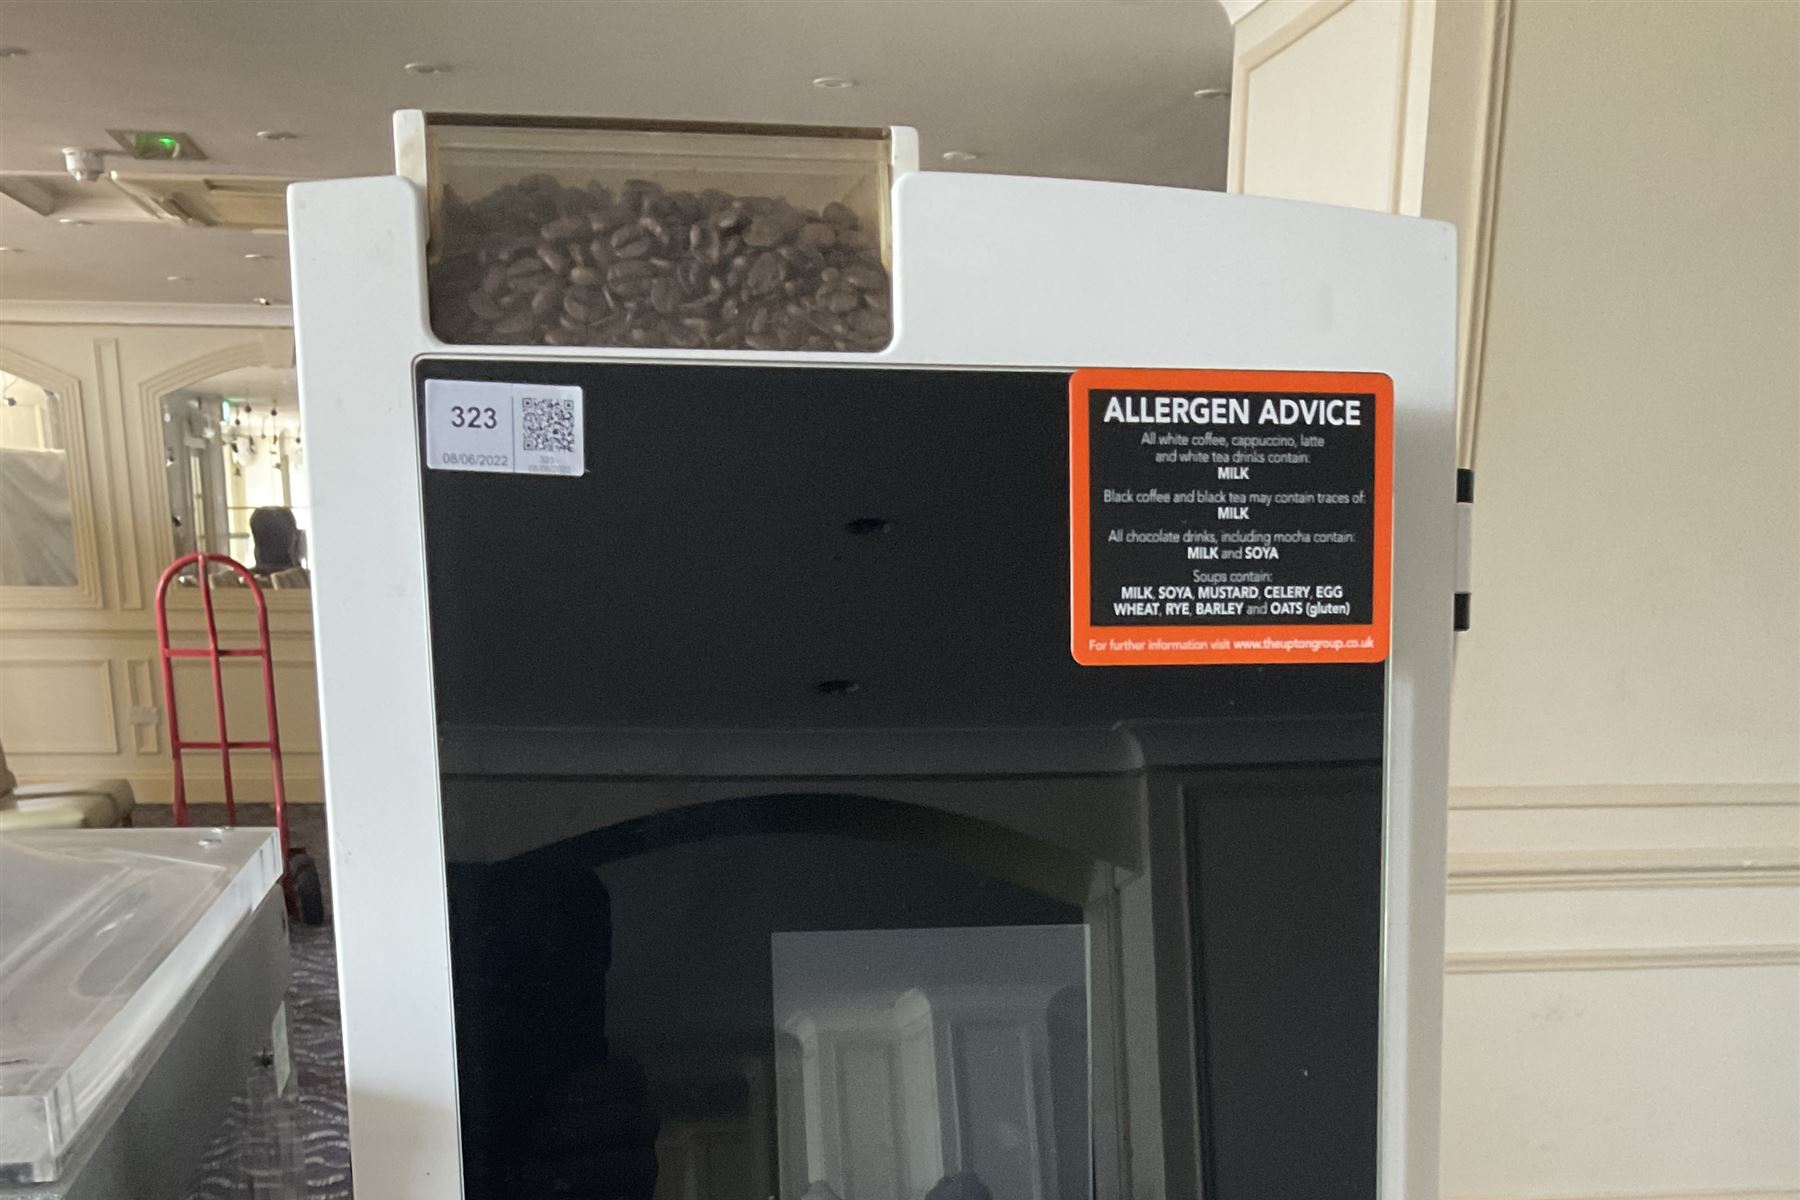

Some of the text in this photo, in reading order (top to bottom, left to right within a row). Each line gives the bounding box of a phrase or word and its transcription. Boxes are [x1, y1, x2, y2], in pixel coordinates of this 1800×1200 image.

[451, 405, 498, 430] 323
[1103, 396, 1361, 426] ALLERGEN ADVICE
[1141, 432, 1325, 449] All white coffee, cappuccino, latte
[442, 452, 509, 467] 08/06/2022
[1155, 449, 1311, 464] and white tea drinks contain:
[1217, 466, 1250, 480] MILK
[1103, 488, 1134, 503] Black
[1136, 488, 1171, 503] coffee
[1173, 489, 1195, 503] and
[1197, 489, 1227, 503] black
[1229, 491, 1247, 503] tea
[1249, 493, 1273, 507] may
[1275, 491, 1315, 504] contain
[1317, 492, 1350, 504] traces
[1217, 506, 1250, 520] MILK
[1107, 529, 1356, 546] All chocolate drinks, including mocha contain:
[1187, 546, 1280, 560] MILK and SOYA
[1192, 569, 1273, 585] Soups contain:
[1121, 585, 1343, 601] MILK, SOYA, MUSTARD, CELERY, EGG
[1113, 601, 1351, 618] WHEAT, RYE, BARLEY and OATS (gluten)
[1088, 636, 1375, 653] For further information visit www.theuptongroup.co.uk
